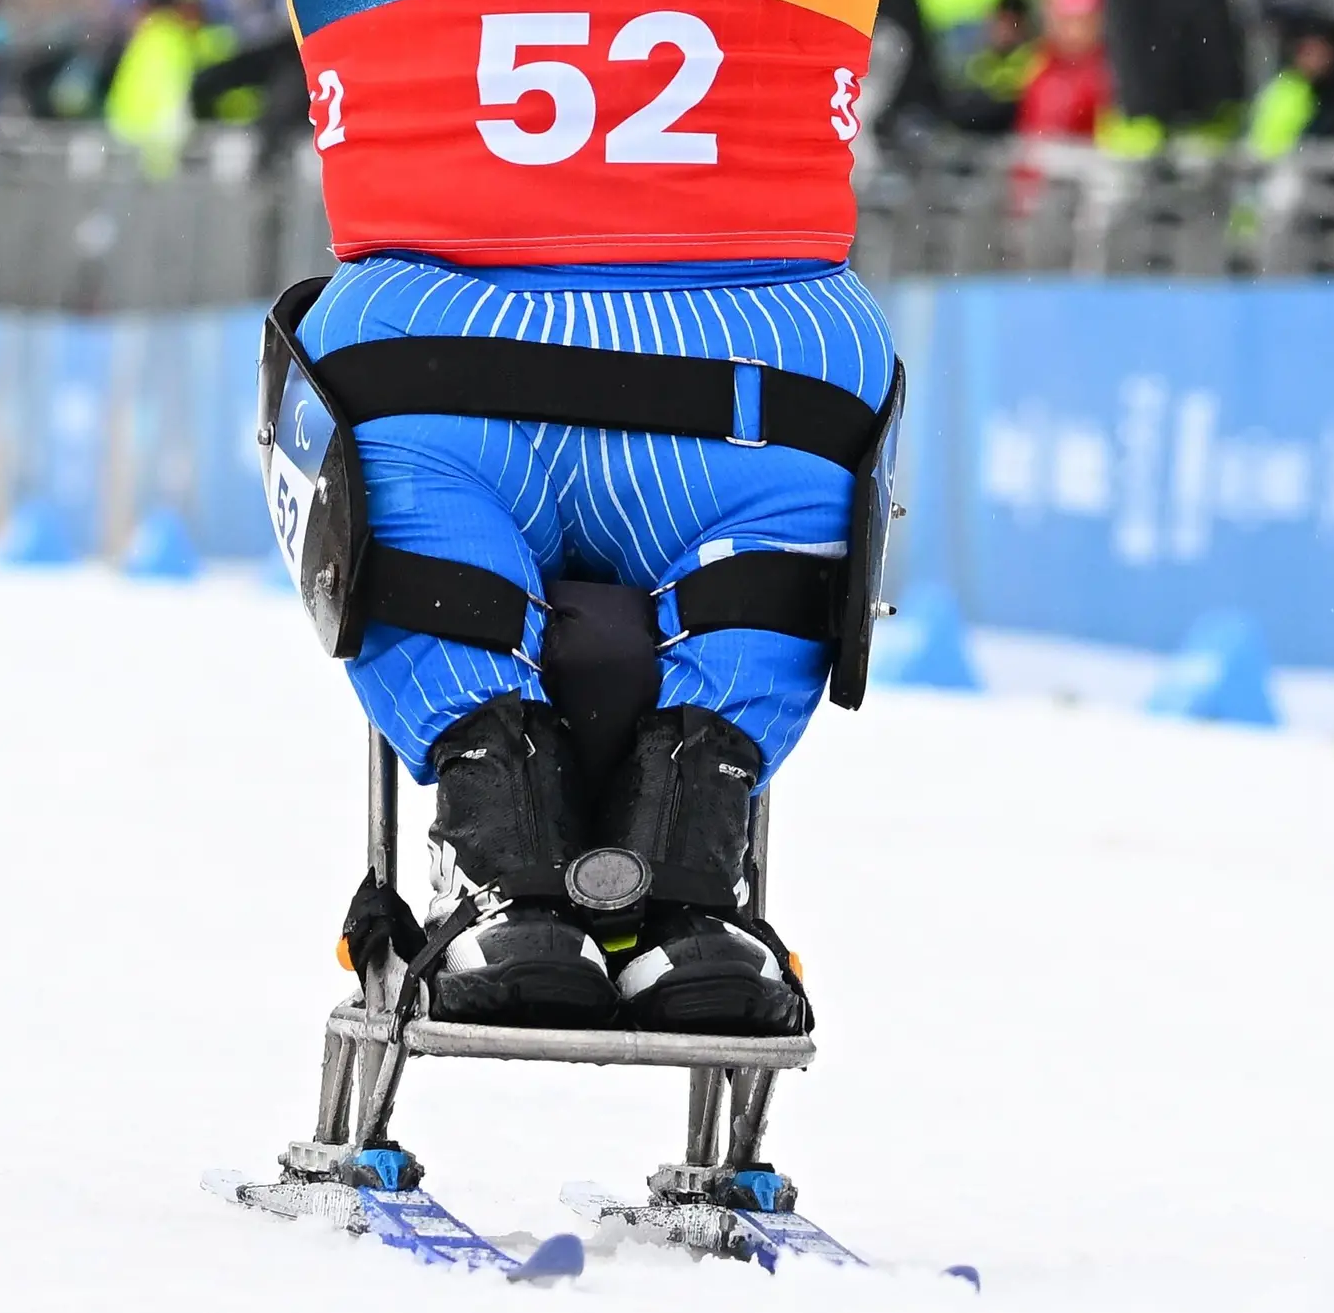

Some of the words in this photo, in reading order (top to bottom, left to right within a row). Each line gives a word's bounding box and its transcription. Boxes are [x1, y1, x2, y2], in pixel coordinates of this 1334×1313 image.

[309, 69, 347, 151] 2
[475, 10, 725, 165] 52
[277, 472, 299, 563] 52
